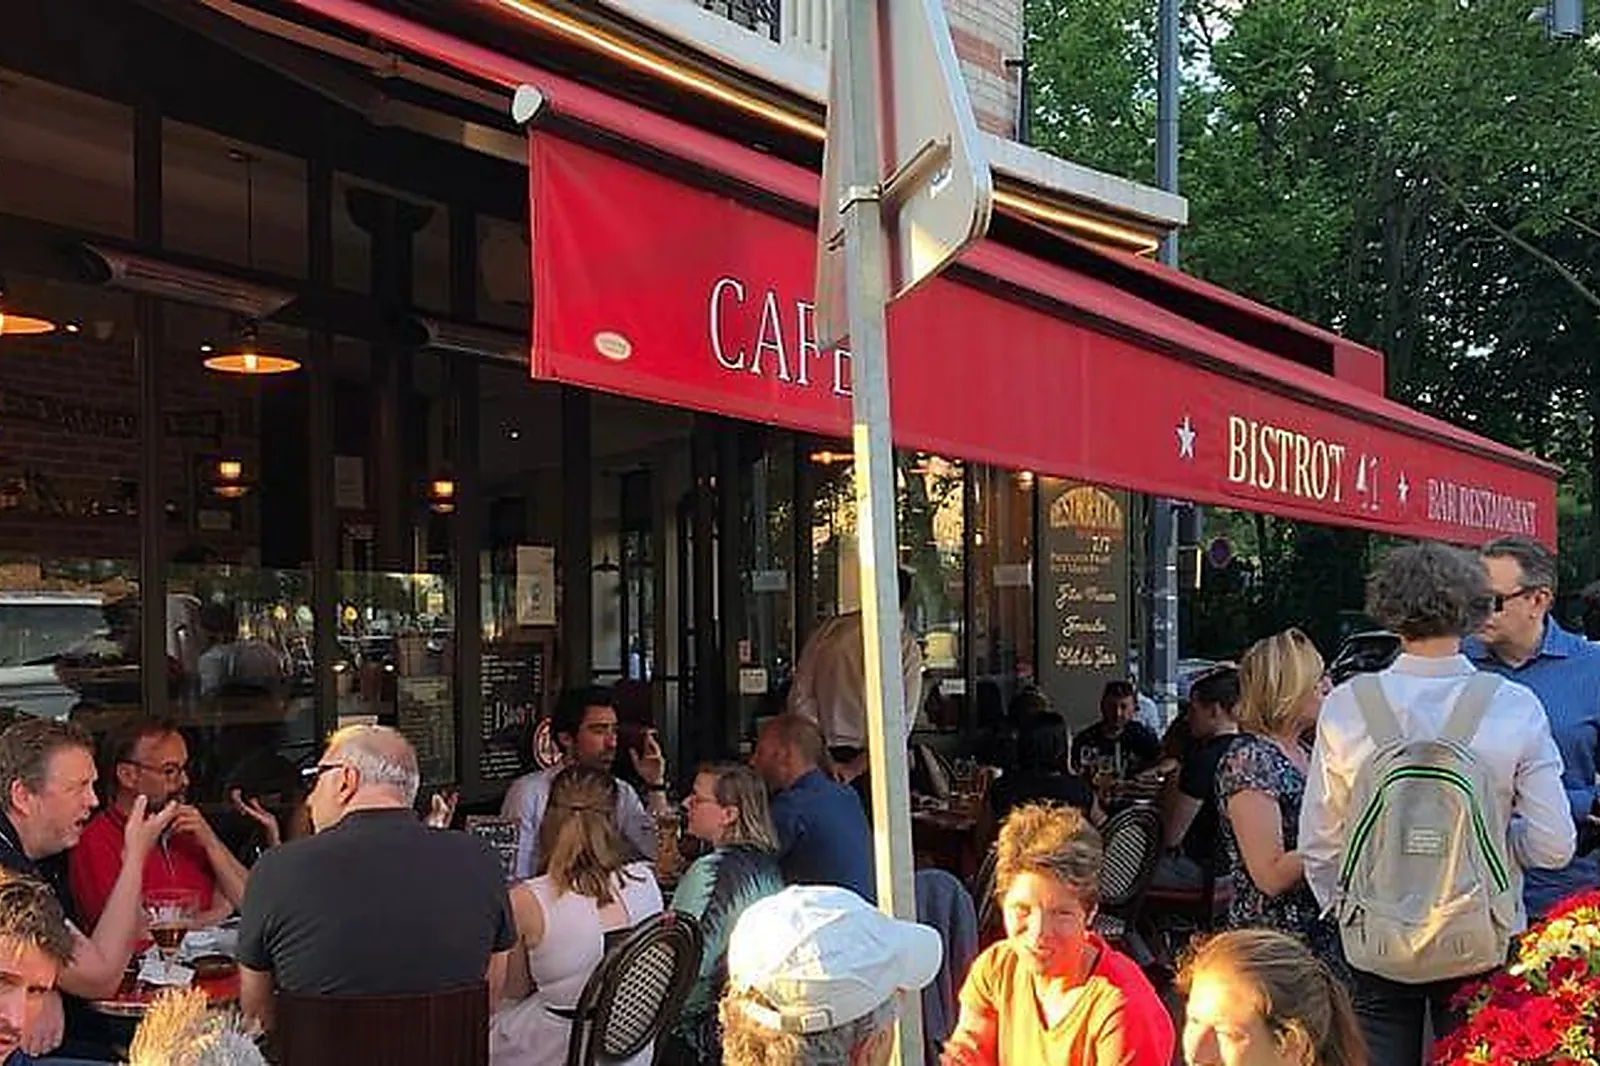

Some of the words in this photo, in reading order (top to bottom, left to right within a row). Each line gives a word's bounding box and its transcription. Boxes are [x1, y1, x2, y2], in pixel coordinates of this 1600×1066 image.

[1228, 415, 1346, 503] BISTROT
[1427, 478, 1457, 522] BAR
[1459, 485, 1536, 537] RESTAURANT
